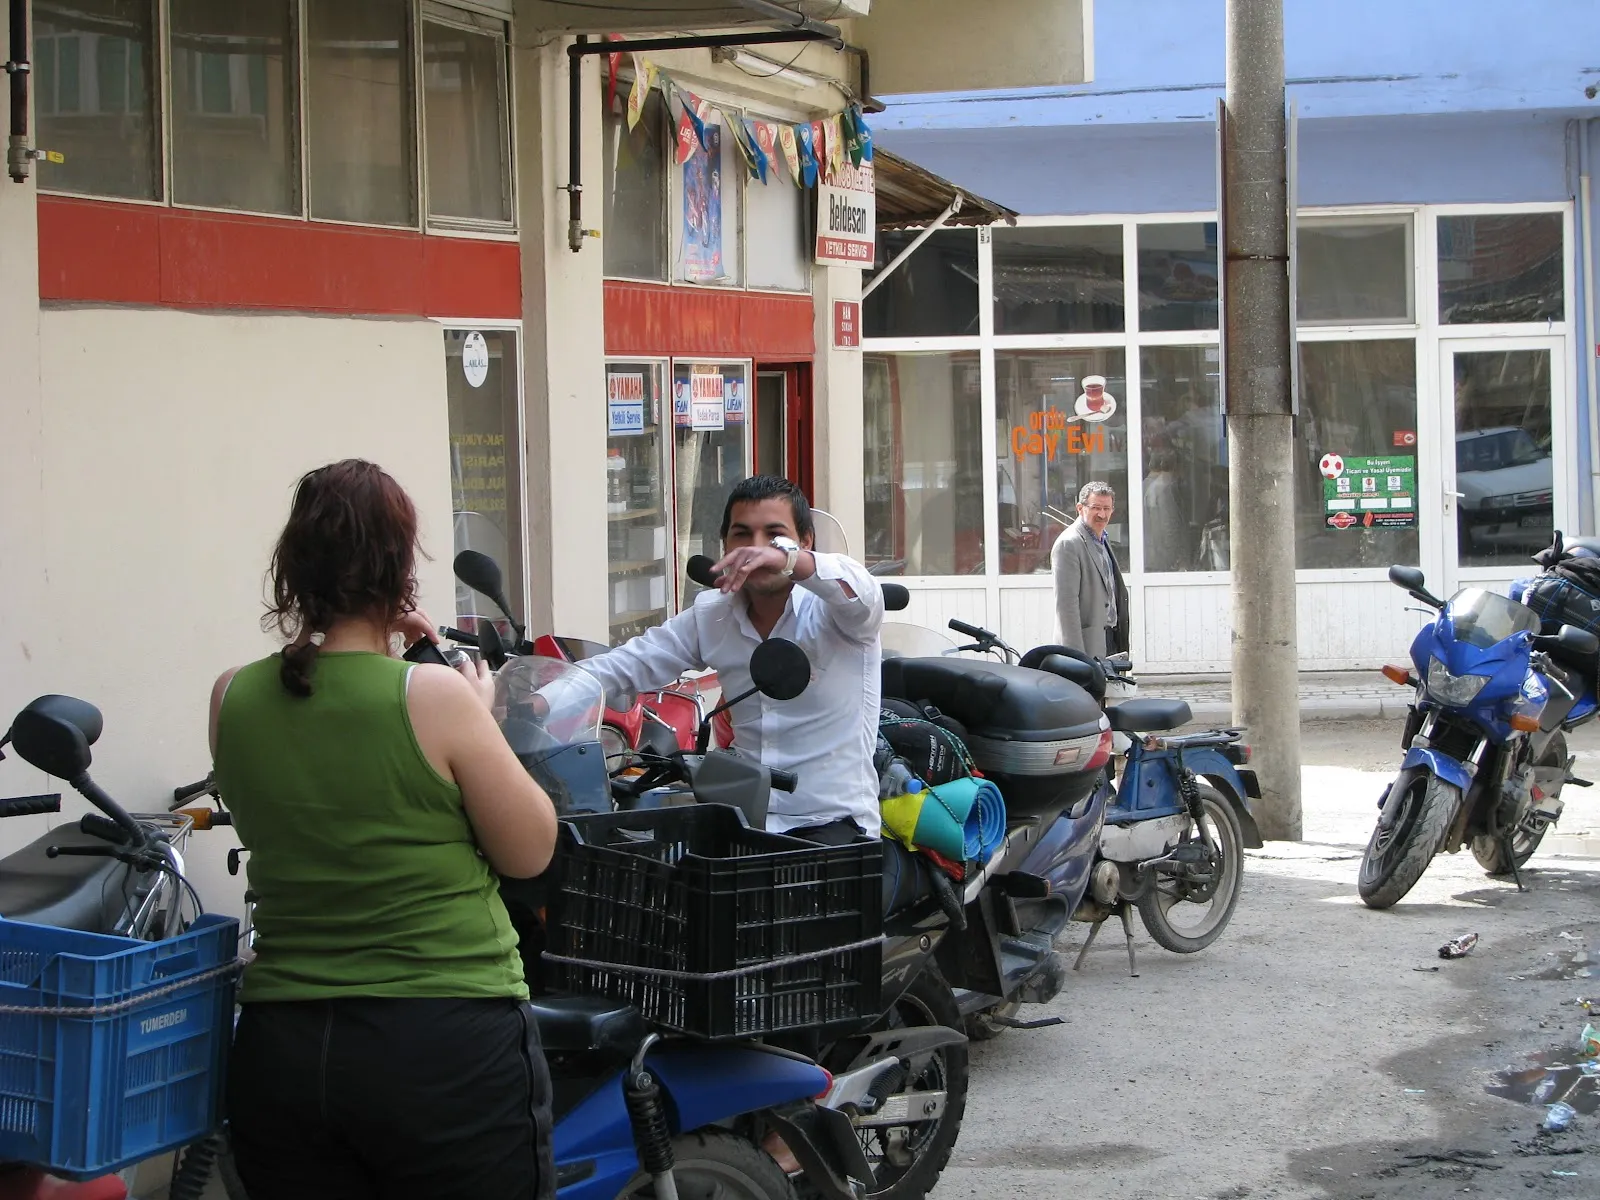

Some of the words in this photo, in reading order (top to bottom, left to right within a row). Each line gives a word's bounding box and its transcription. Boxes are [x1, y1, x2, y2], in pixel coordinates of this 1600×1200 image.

[829, 193, 867, 234] Beldesan
[616, 377, 643, 400] YAMAHA
[699, 377, 723, 397] YAMAHA
[726, 398, 743, 411] LIFAN
[1029, 405, 1065, 430] ordu
[1011, 426, 1059, 462] Çay
[1067, 425, 1105, 455] Evi
